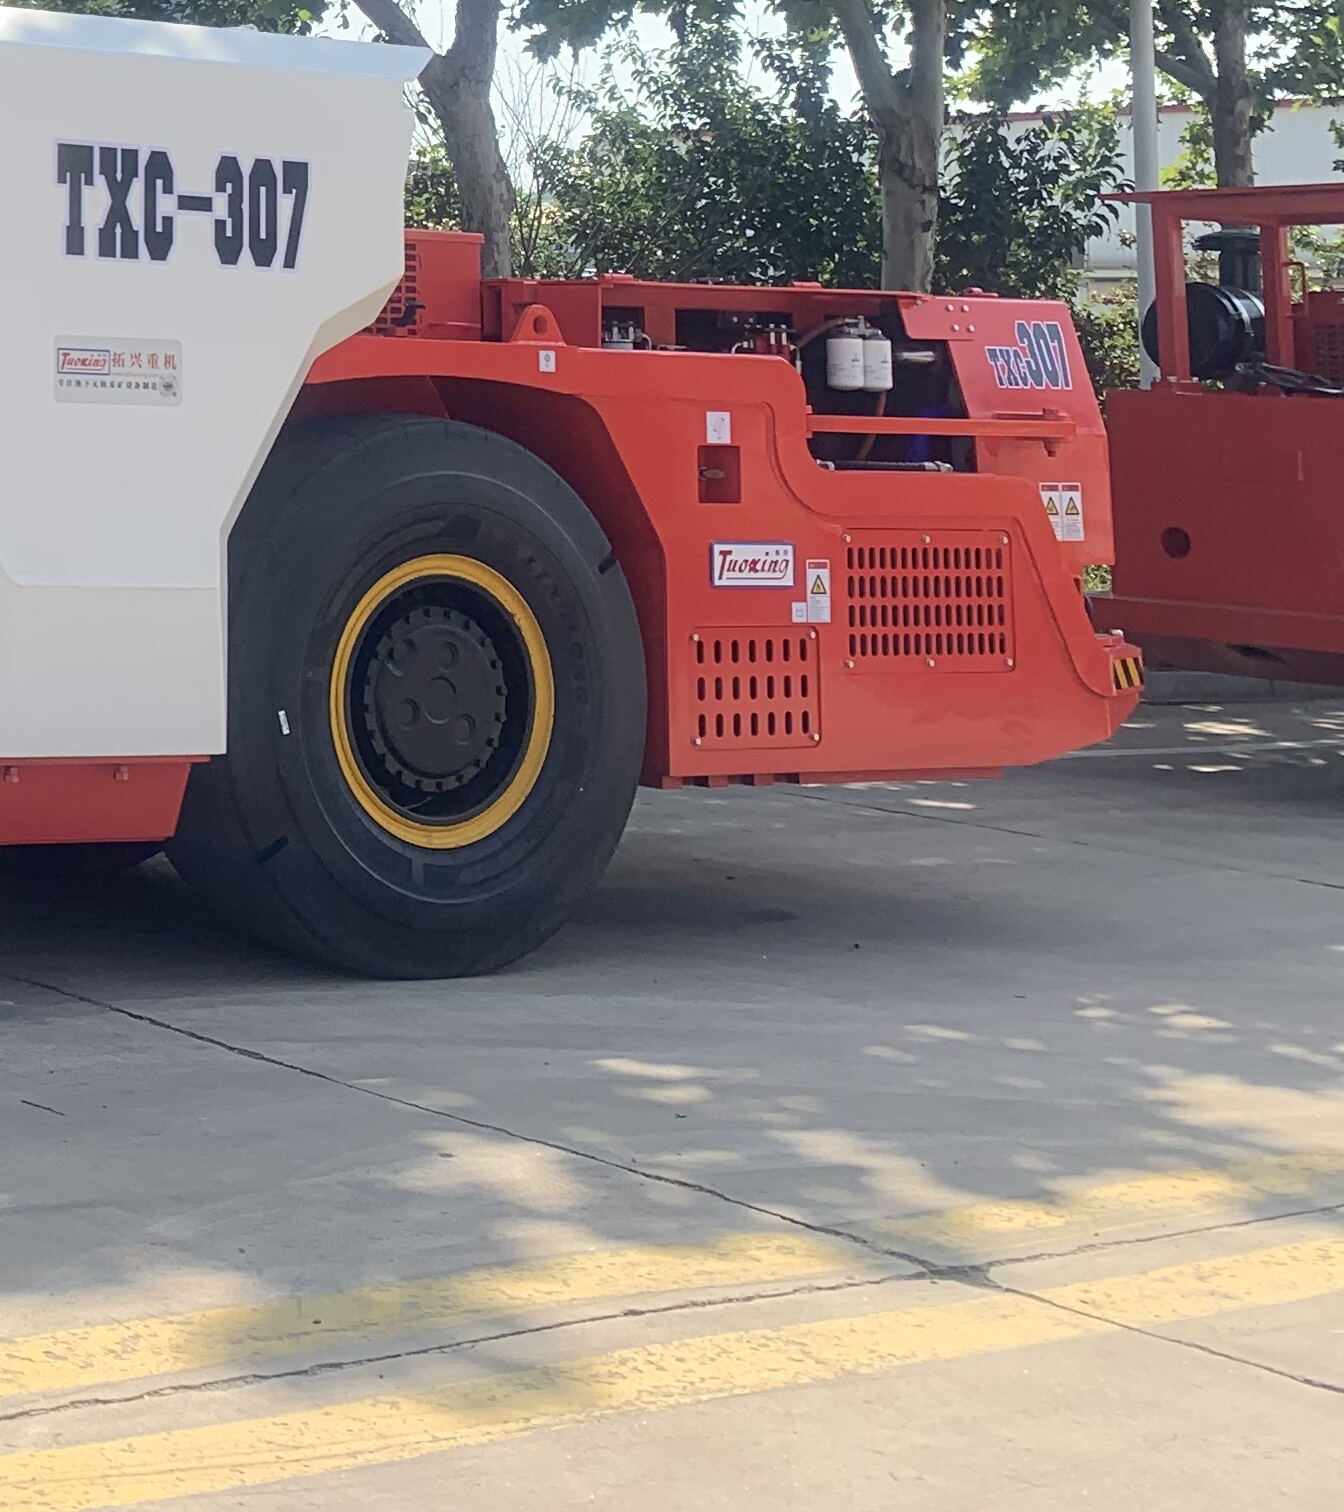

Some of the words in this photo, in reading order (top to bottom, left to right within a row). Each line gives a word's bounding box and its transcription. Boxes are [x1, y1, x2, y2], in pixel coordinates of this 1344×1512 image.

[56, 142, 310, 270] TXC-307
[111, 351, 177, 370] 拓兴重机
